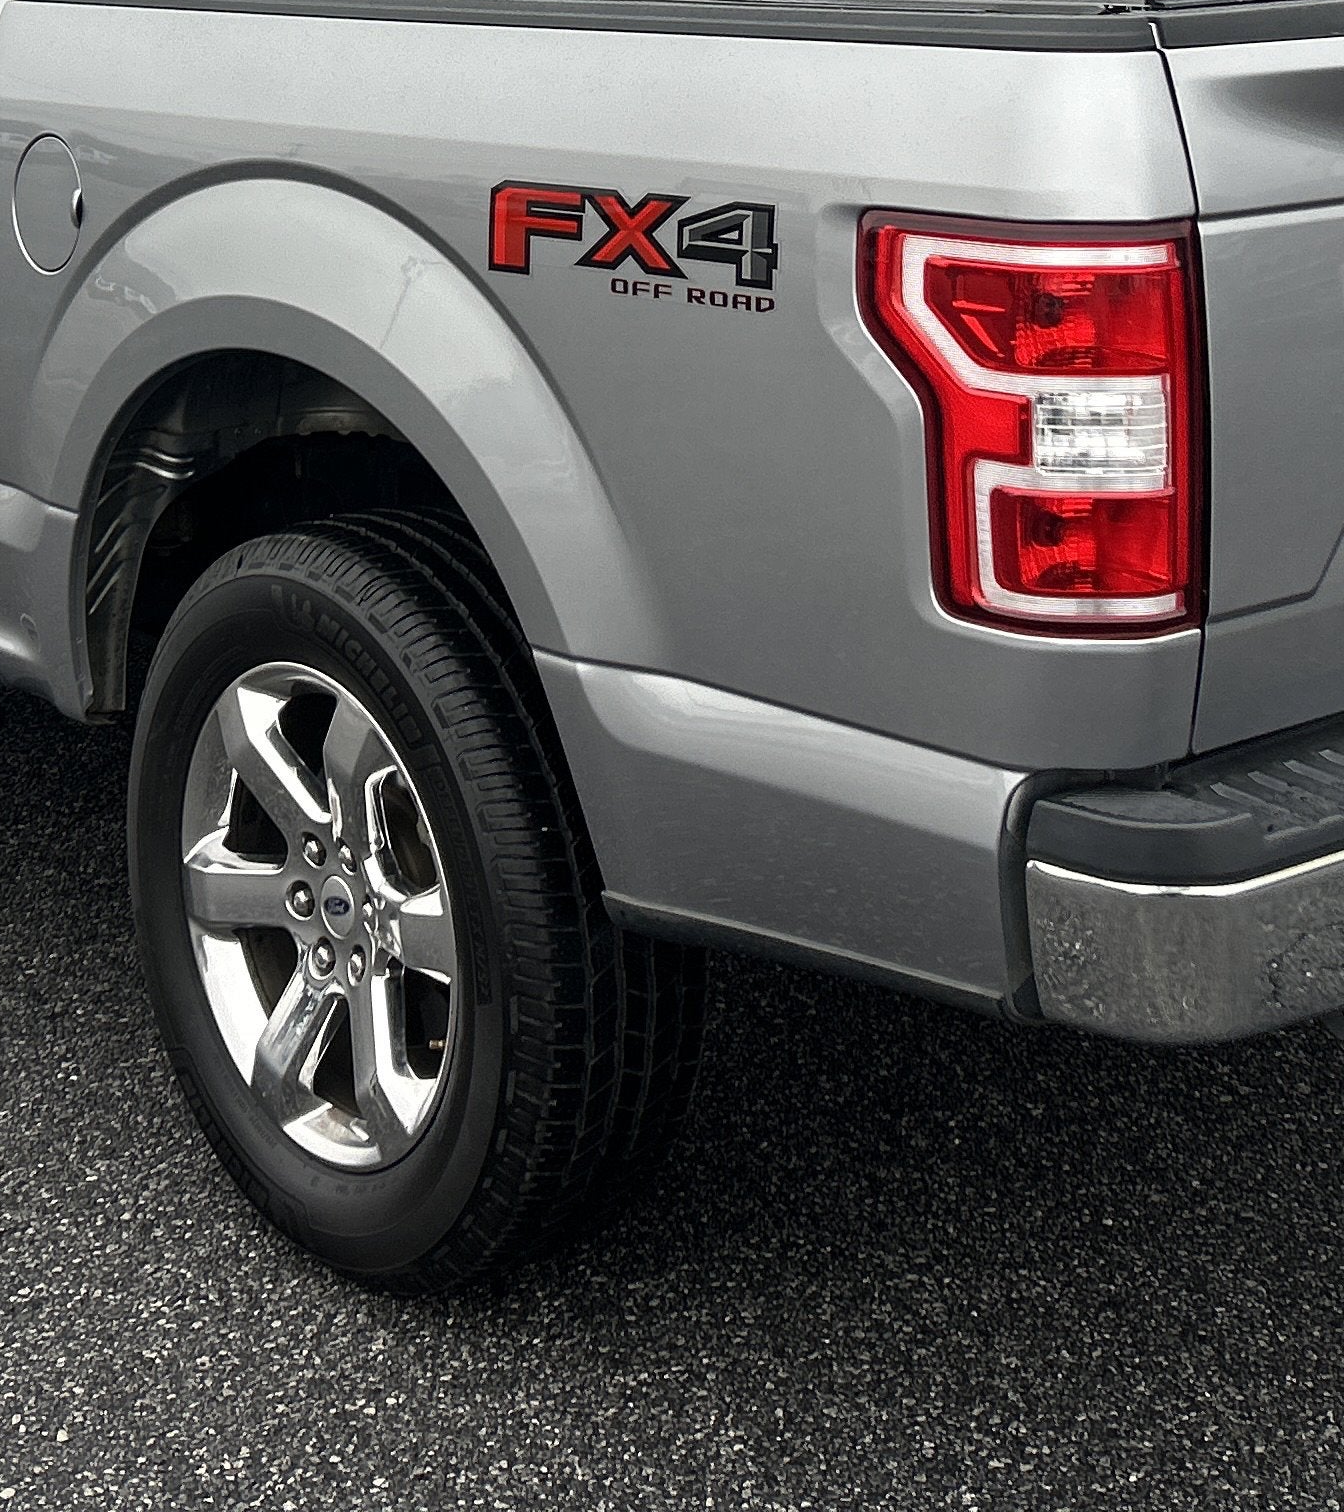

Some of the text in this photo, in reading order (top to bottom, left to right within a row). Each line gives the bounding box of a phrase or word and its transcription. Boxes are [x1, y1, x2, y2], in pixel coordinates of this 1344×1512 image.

[488, 179, 779, 290] FX4
[611, 278, 775, 313] OFF ROAD
[317, 612, 422, 750] MICHELIN
